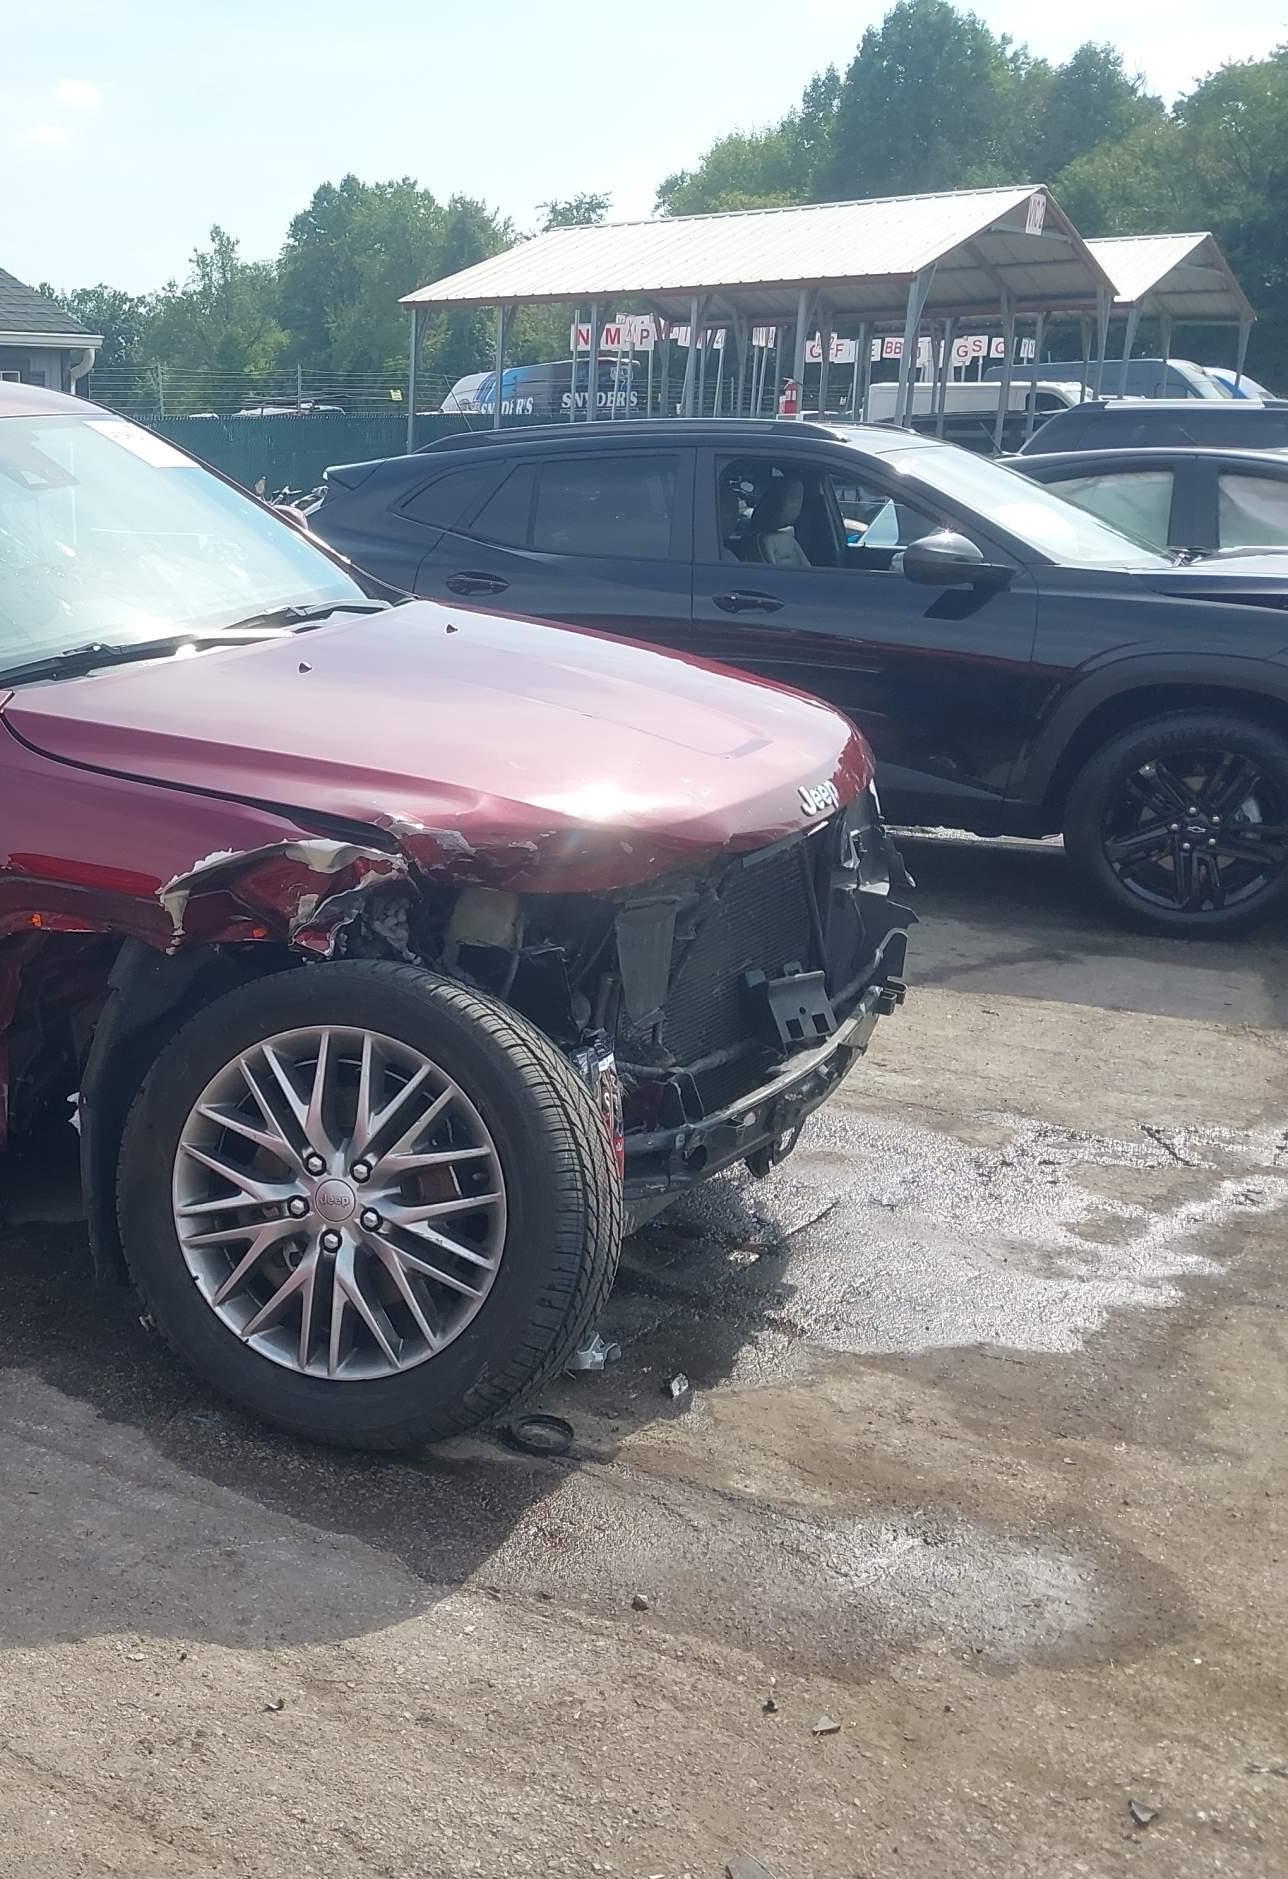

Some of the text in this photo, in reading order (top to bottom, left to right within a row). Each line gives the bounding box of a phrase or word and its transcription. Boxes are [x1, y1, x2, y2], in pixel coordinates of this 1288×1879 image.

[577, 328, 590, 346] N
[605, 327, 621, 345] M
[639, 328, 650, 346] P
[835, 343, 845, 358] F
[884, 341, 902, 355] BB
[956, 344, 969, 358] G
[972, 339, 983, 353] S
[797, 780, 840, 816] Jeep
[319, 1193, 351, 1208] Jeep
